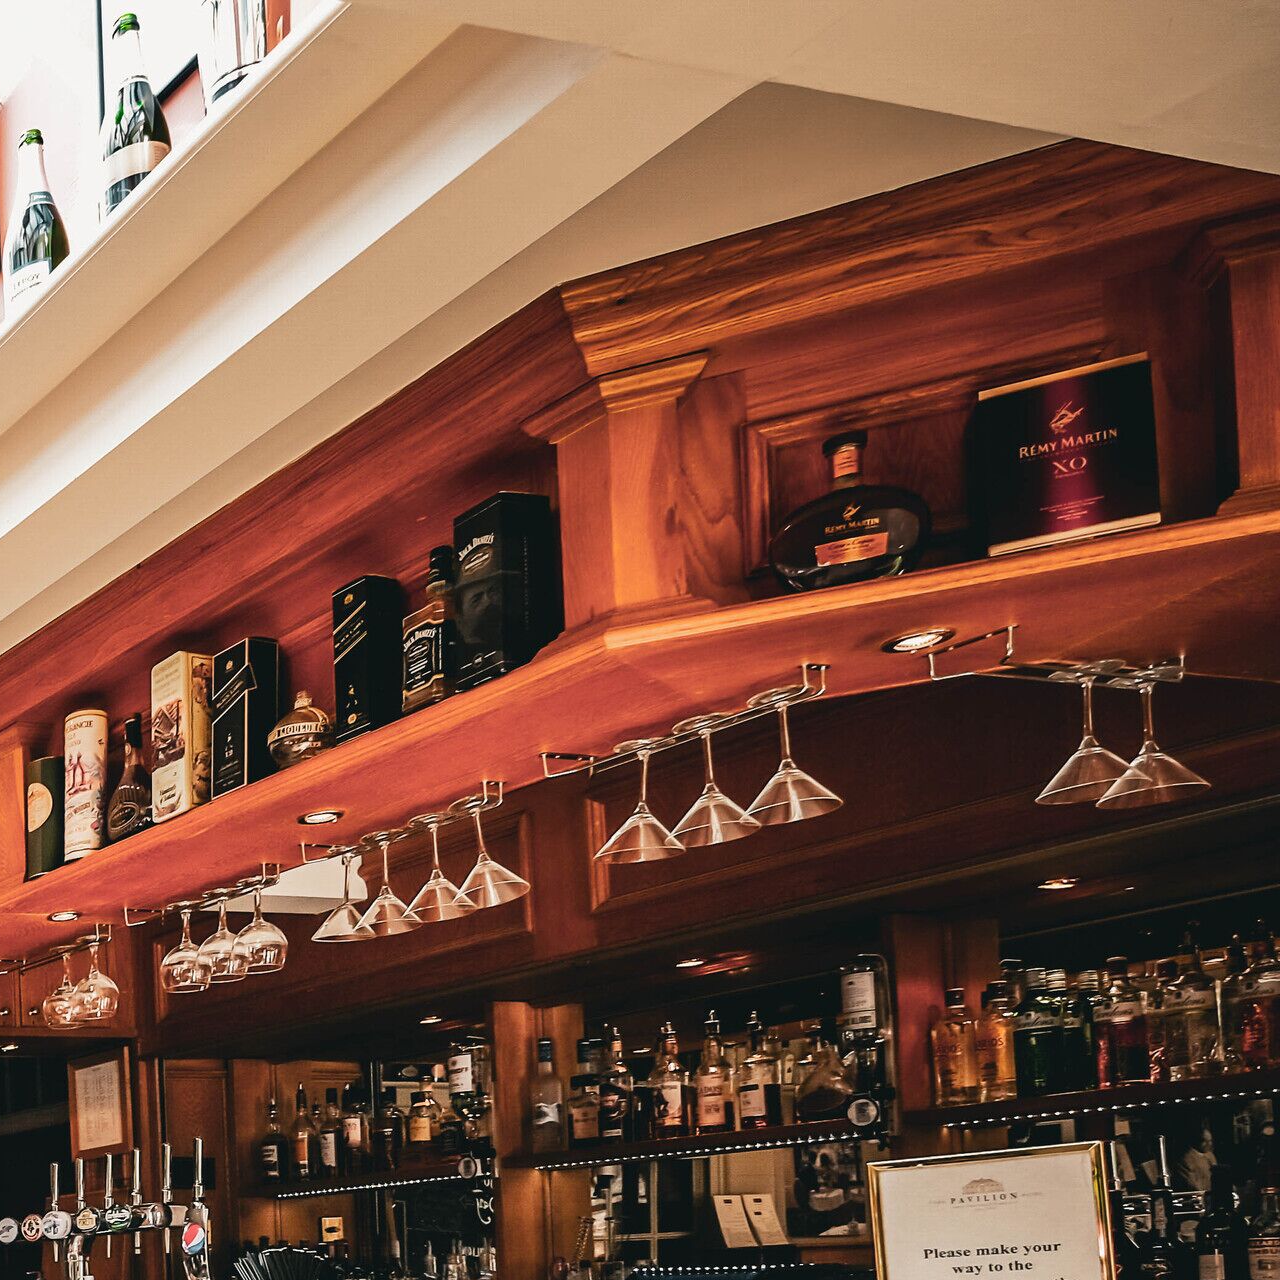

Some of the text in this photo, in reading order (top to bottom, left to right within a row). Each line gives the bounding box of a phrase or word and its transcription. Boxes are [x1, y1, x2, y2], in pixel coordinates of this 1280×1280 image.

[1061, 428, 1118, 449] MARTIN
[1052, 456, 1087, 475] XO
[950, 1192, 1018, 1204] PAVILION
[923, 1243, 1062, 1259] Please make your
[952, 1260, 1033, 1275] way to the
